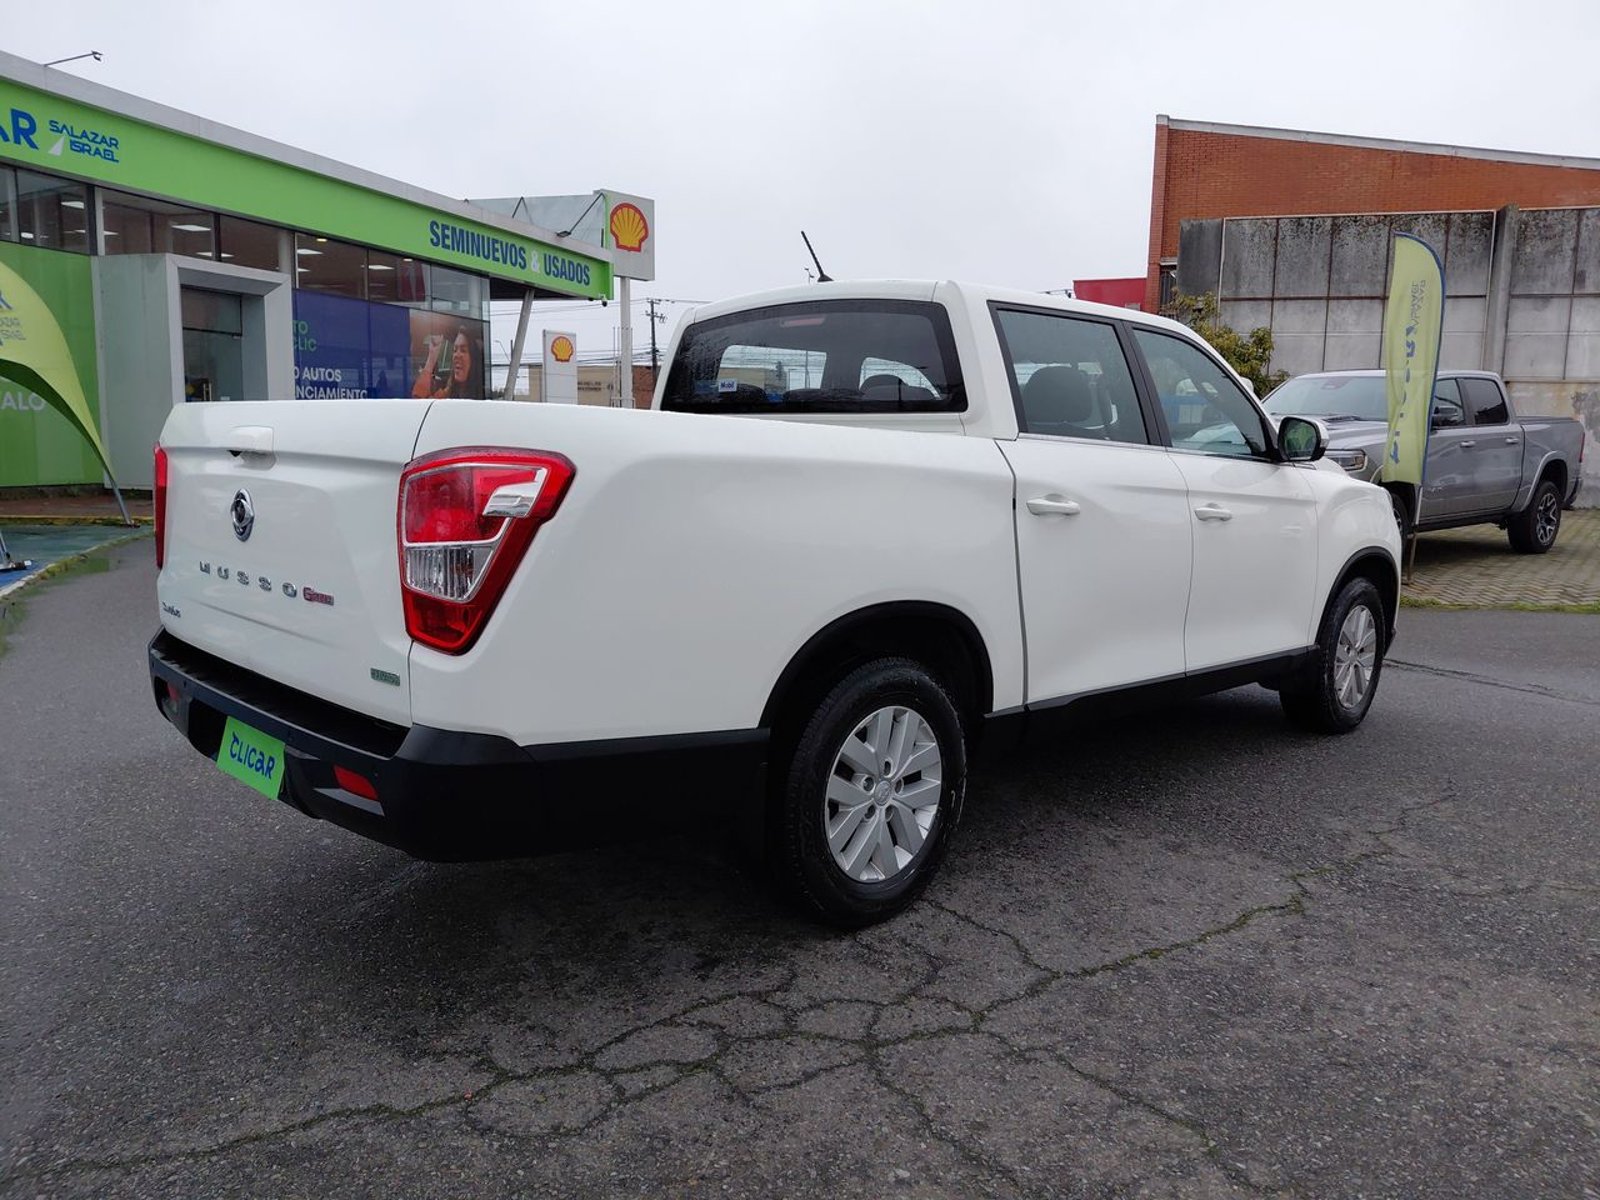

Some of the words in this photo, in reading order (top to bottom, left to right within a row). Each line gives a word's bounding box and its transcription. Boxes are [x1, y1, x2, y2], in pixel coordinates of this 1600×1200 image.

[0, 108, 39, 150] R
[48, 119, 120, 150] SALAZAR
[69, 139, 120, 163] ISRAEL
[429, 220, 528, 270] SEMINUEVOS
[530, 250, 541, 275] &
[543, 253, 590, 286] USADOS
[302, 366, 342, 382] AUTOS
